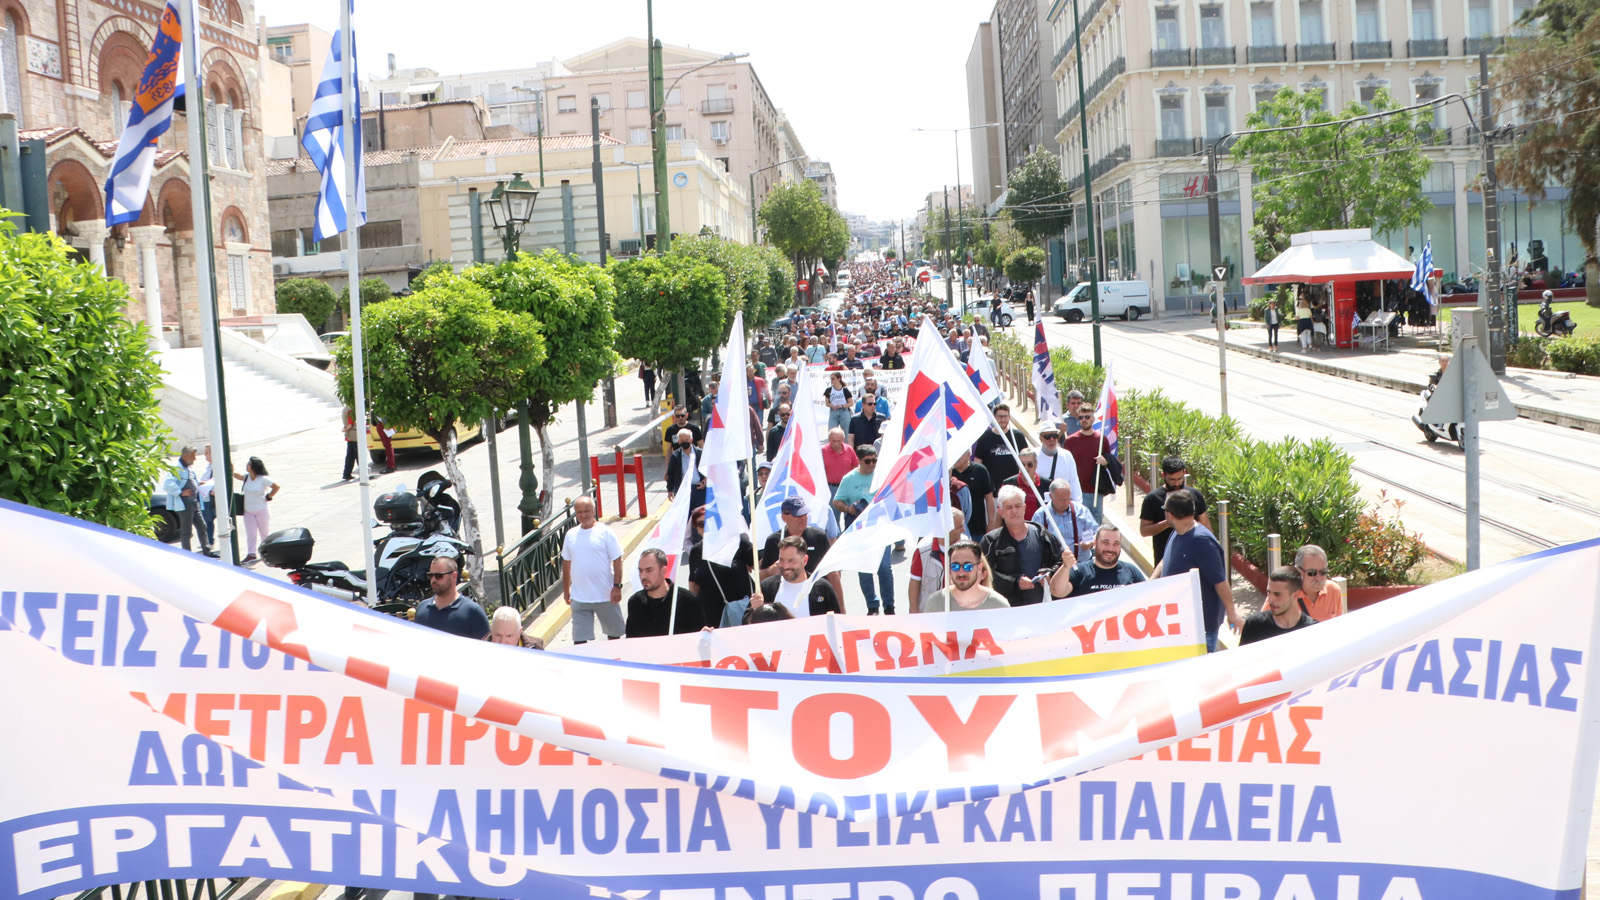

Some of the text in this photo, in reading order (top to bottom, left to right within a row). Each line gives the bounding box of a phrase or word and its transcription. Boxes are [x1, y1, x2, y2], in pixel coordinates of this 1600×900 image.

[803, 628, 1004, 674] ΑΓΩΝΑ
[13, 814, 528, 896] ΕΡΓΑΤΙΚΟ
[427, 787, 731, 856] ΔΗΜΟΣΙΑ
[963, 787, 1053, 843] ΚΑΙ
[1080, 781, 1342, 844] ΠΑΙΔΕΙΑ
